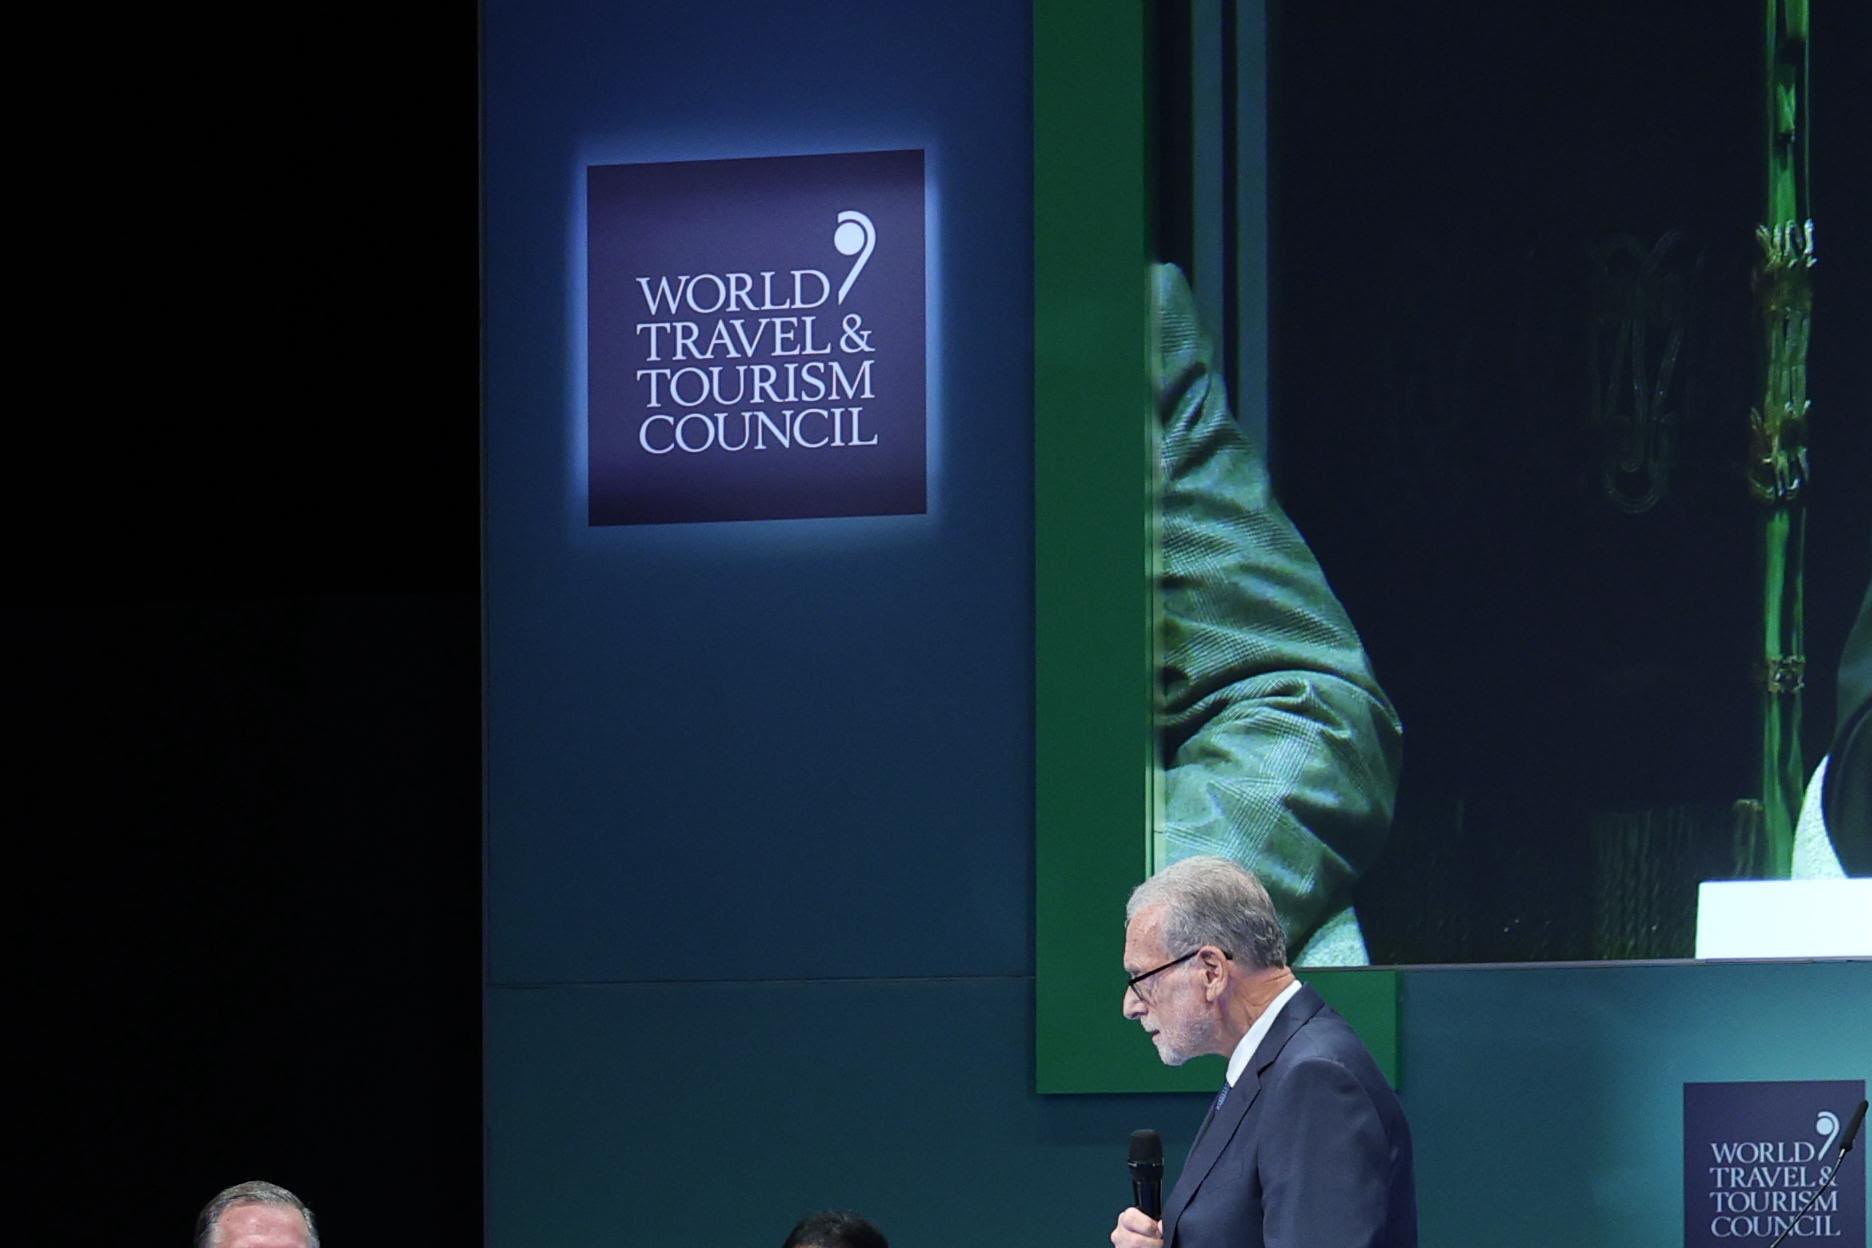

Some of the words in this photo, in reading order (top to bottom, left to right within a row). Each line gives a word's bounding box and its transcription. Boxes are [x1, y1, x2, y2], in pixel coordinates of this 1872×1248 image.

[636, 270, 831, 315] WORLD
[636, 316, 831, 361] TRAVEL
[839, 313, 875, 353] &
[636, 359, 875, 408] TOURISM
[639, 408, 878, 454] COUNCIL
[1710, 1142, 1815, 1164] WORLD
[1709, 1166, 1818, 1188] TRAVEL
[1818, 1166, 1837, 1188] &
[1709, 1191, 1838, 1213] TOURISM
[1711, 1215, 1841, 1238] COUNCIL
